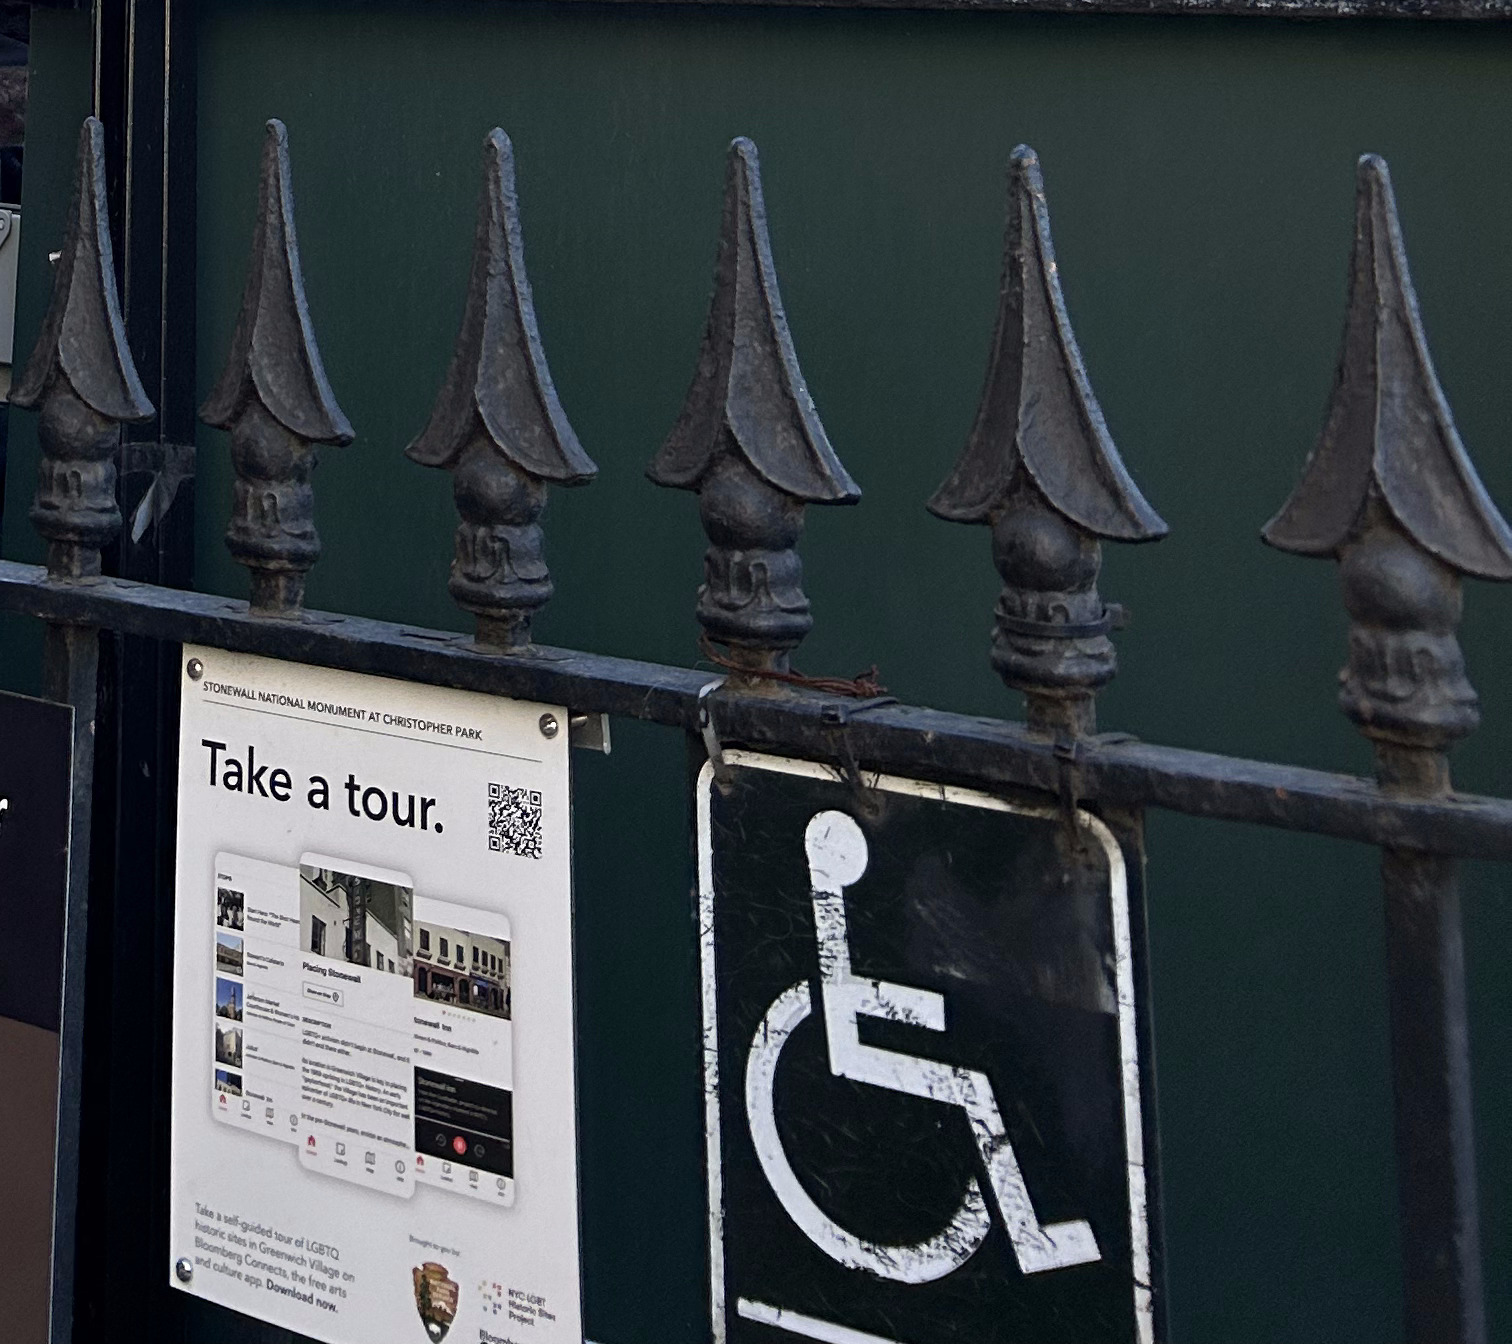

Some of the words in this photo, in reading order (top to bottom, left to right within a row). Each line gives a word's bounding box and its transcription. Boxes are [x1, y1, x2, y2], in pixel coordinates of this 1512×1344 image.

[203, 680, 257, 701] STONEWALL
[258, 691, 306, 710] NATIONAL
[307, 699, 366, 721] MONUMENT
[368, 711, 382, 723] AT
[383, 713, 453, 736] CHRISTOPHER
[455, 726, 483, 741] PARK
[201, 739, 292, 802] Take
[307, 775, 330, 811] a
[345, 774, 443, 834] tour.
[194, 1219, 226, 1240] historic
[227, 1231, 247, 1248] sites
[248, 1240, 257, 1250] in
[258, 1241, 307, 1268] Greenwich
[308, 1256, 340, 1280] Village
[342, 1272, 356, 1283] on
[195, 1201, 214, 1220] Take
[216, 1212, 222, 1222] a
[224, 1214, 273, 1239] self-guided
[274, 1230, 293, 1245] tour
[295, 1236, 305, 1248] of
[306, 1239, 340, 1261] LGBTQ
[194, 1235, 243, 1266] Bloomberg
[291, 1269, 307, 1285] the
[308, 1274, 327, 1292] free
[328, 1284, 347, 1299] arts
[194, 1255, 211, 1270] and
[212, 1262, 243, 1281] culture
[266, 1278, 314, 1305] Download
[315, 1297, 339, 1314] now.
